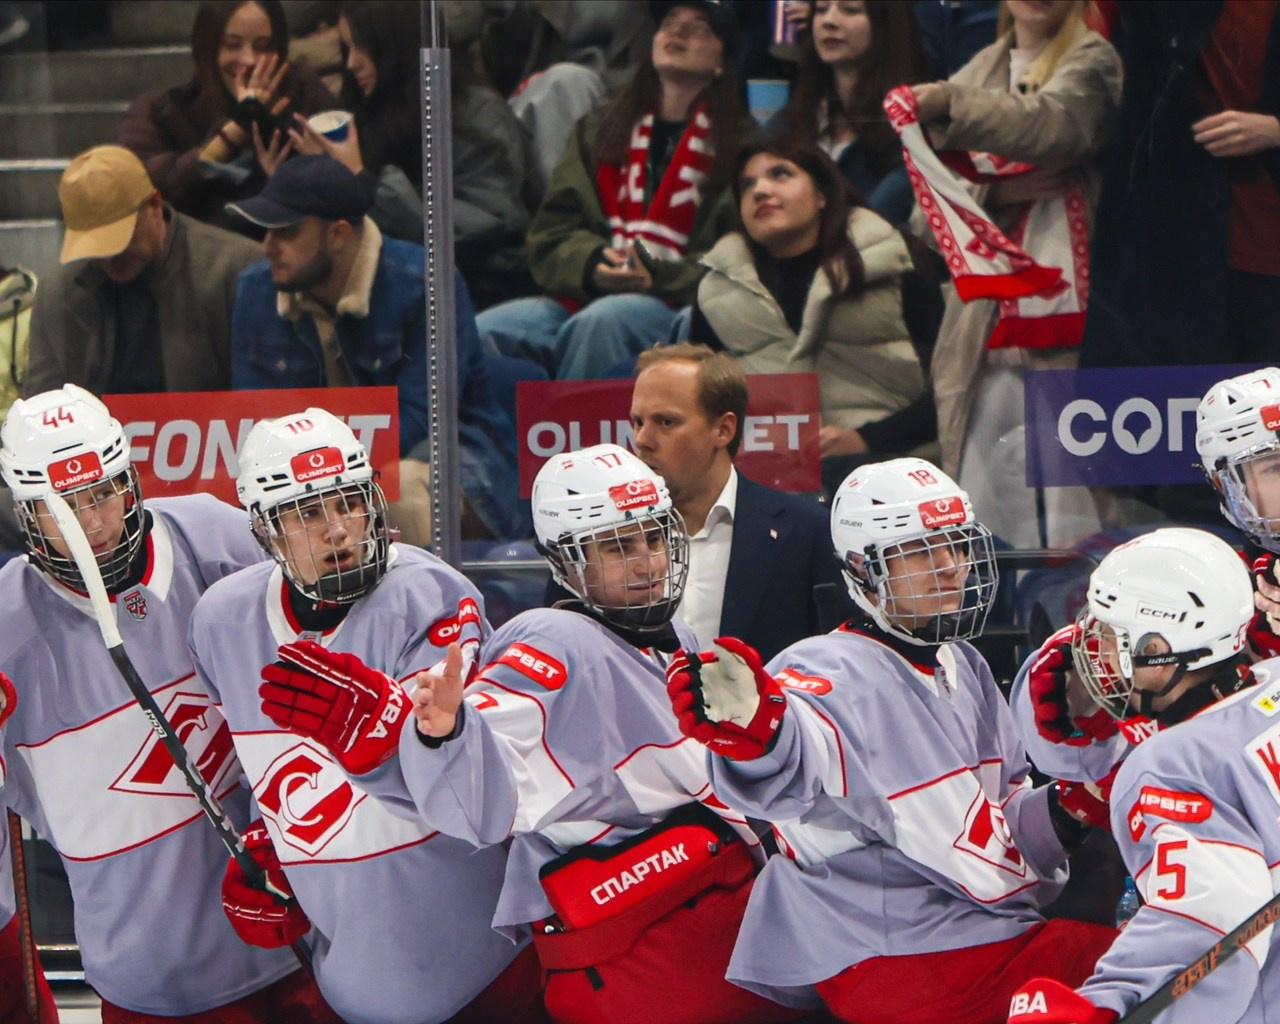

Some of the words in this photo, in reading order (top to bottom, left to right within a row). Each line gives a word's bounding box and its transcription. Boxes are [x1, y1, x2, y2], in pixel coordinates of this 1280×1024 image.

[42, 406, 74, 429] 44
[284, 419, 316, 436] 10
[527, 414, 810, 458] OLIET
[121, 414, 391, 482] FONT
[595, 453, 624, 469] 17
[55, 469, 101, 489] OLIMPBET
[297, 464, 344, 482] OLIMPBET
[907, 469, 938, 488] 18
[616, 492, 658, 509] OLIMPBET
[925, 511, 966, 526] OLIMPBET
[1140, 608, 1177, 620] CCM
[590, 843, 689, 905] СПАРТАК
[1008, 990, 1048, 1017] ВА
